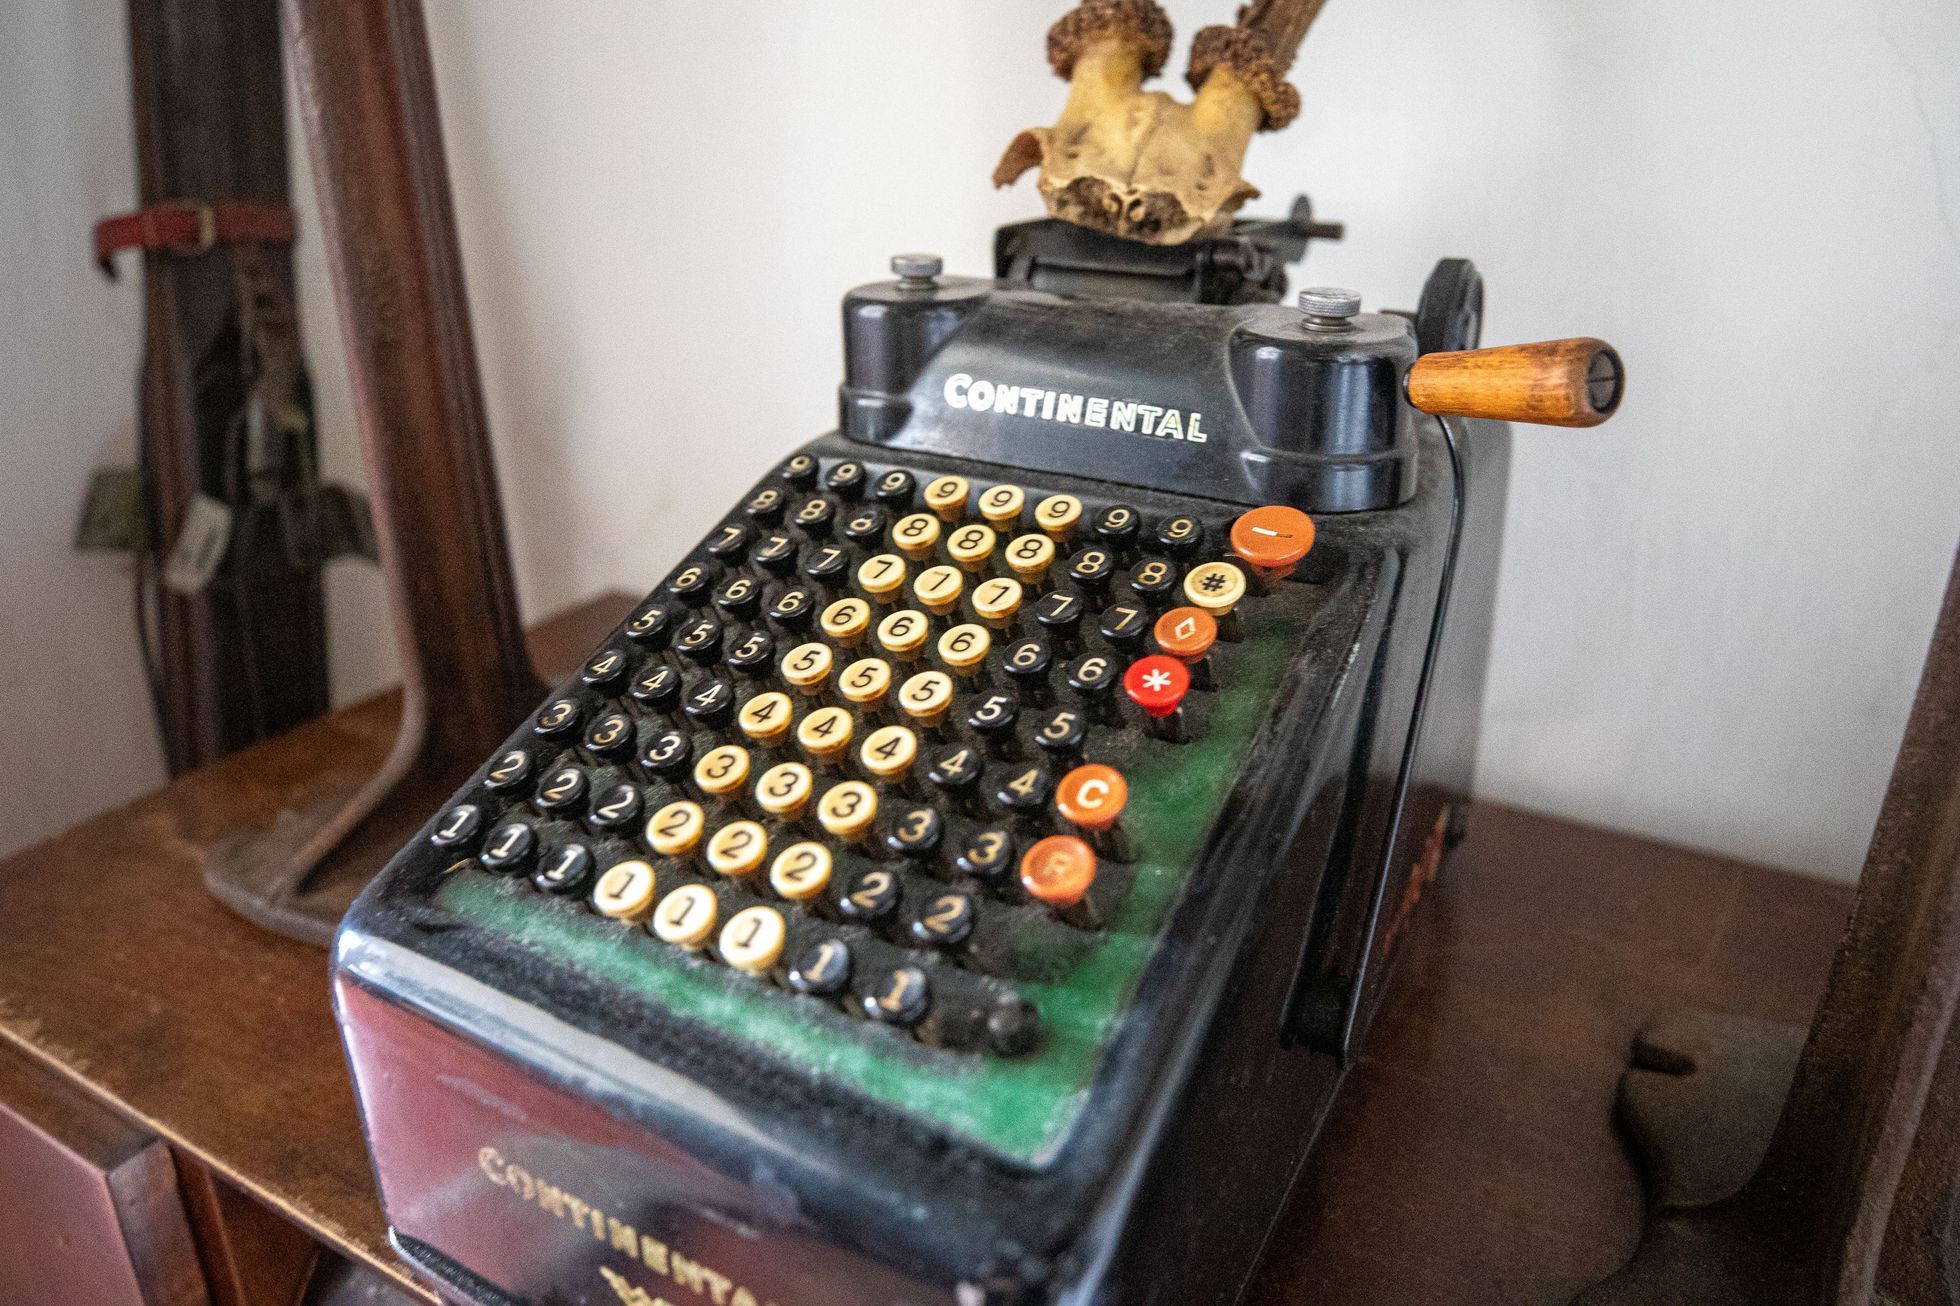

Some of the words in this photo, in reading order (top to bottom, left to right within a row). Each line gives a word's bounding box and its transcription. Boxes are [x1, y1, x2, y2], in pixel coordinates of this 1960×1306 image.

[944, 373, 1207, 443] CONTINENTAL
[833, 463, 857, 481] 9
[882, 472, 905, 490] 9
[748, 490, 778, 508] 8
[937, 482, 958, 497] 9
[990, 491, 1012, 507] 9
[800, 500, 826, 519] 8
[1048, 501, 1070, 518] 9
[1104, 509, 1130, 527] 9
[718, 528, 741, 546] 7
[904, 519, 928, 536] 8
[1168, 519, 1193, 537] 9
[768, 537, 788, 555] 7
[957, 530, 983, 549] 8
[1017, 539, 1042, 558] 8
[817, 549, 840, 567] 7
[1076, 552, 1104, 572] 8
[676, 568, 701, 587] 6
[873, 560, 893, 578] 7
[1138, 563, 1167, 583] 8
[726, 579, 751, 598] 6
[929, 571, 951, 591] 7
[777, 592, 804, 610] 6
[989, 584, 1010, 604] 7
[833, 606, 856, 625] 6
[1051, 594, 1073, 616] 7
[633, 610, 662, 628] 5
[890, 617, 914, 636] 6
[1115, 608, 1138, 630] 7
[685, 623, 713, 642] 5
[952, 633, 975, 651] 6
[736, 637, 765, 657] 5
[1013, 644, 1040, 665] 6
[591, 656, 617, 674] 4
[793, 650, 820, 670] 5
[1078, 658, 1106, 680] 6
[641, 670, 668, 690] 4
[851, 667, 878, 687] 5
[694, 684, 722, 706] 4
[912, 680, 940, 700] 5
[543, 703, 572, 725] 3
[752, 701, 777, 722] 4
[976, 696, 1007, 719] 5
[594, 719, 624, 742] 3
[813, 716, 836, 737] 4
[1044, 713, 1075, 738] 5
[650, 736, 681, 759] 3
[875, 737, 901, 759] 4
[490, 751, 525, 779] 2
[708, 755, 735, 777] 3
[940, 750, 968, 775] 4
[544, 769, 579, 798] 2
[769, 772, 798, 796] 3
[1009, 769, 1039, 795] 4
[598, 786, 634, 818] 2
[1076, 779, 1109, 808] C
[832, 792, 861, 817] 3
[439, 810, 470, 837] 1
[659, 810, 690, 836] 2
[898, 811, 932, 841] 3
[491, 829, 520, 857] 1
[720, 831, 752, 858] 2
[967, 832, 1003, 864] 3
[546, 849, 577, 879] 1
[785, 852, 816, 881] 2
[609, 873, 634, 899] 1
[853, 872, 890, 908] 2
[668, 896, 695, 925] 1
[925, 896, 964, 932] 2
[735, 918, 761, 947] 1
[805, 944, 833, 981] 1
[880, 970, 908, 1011] 1
